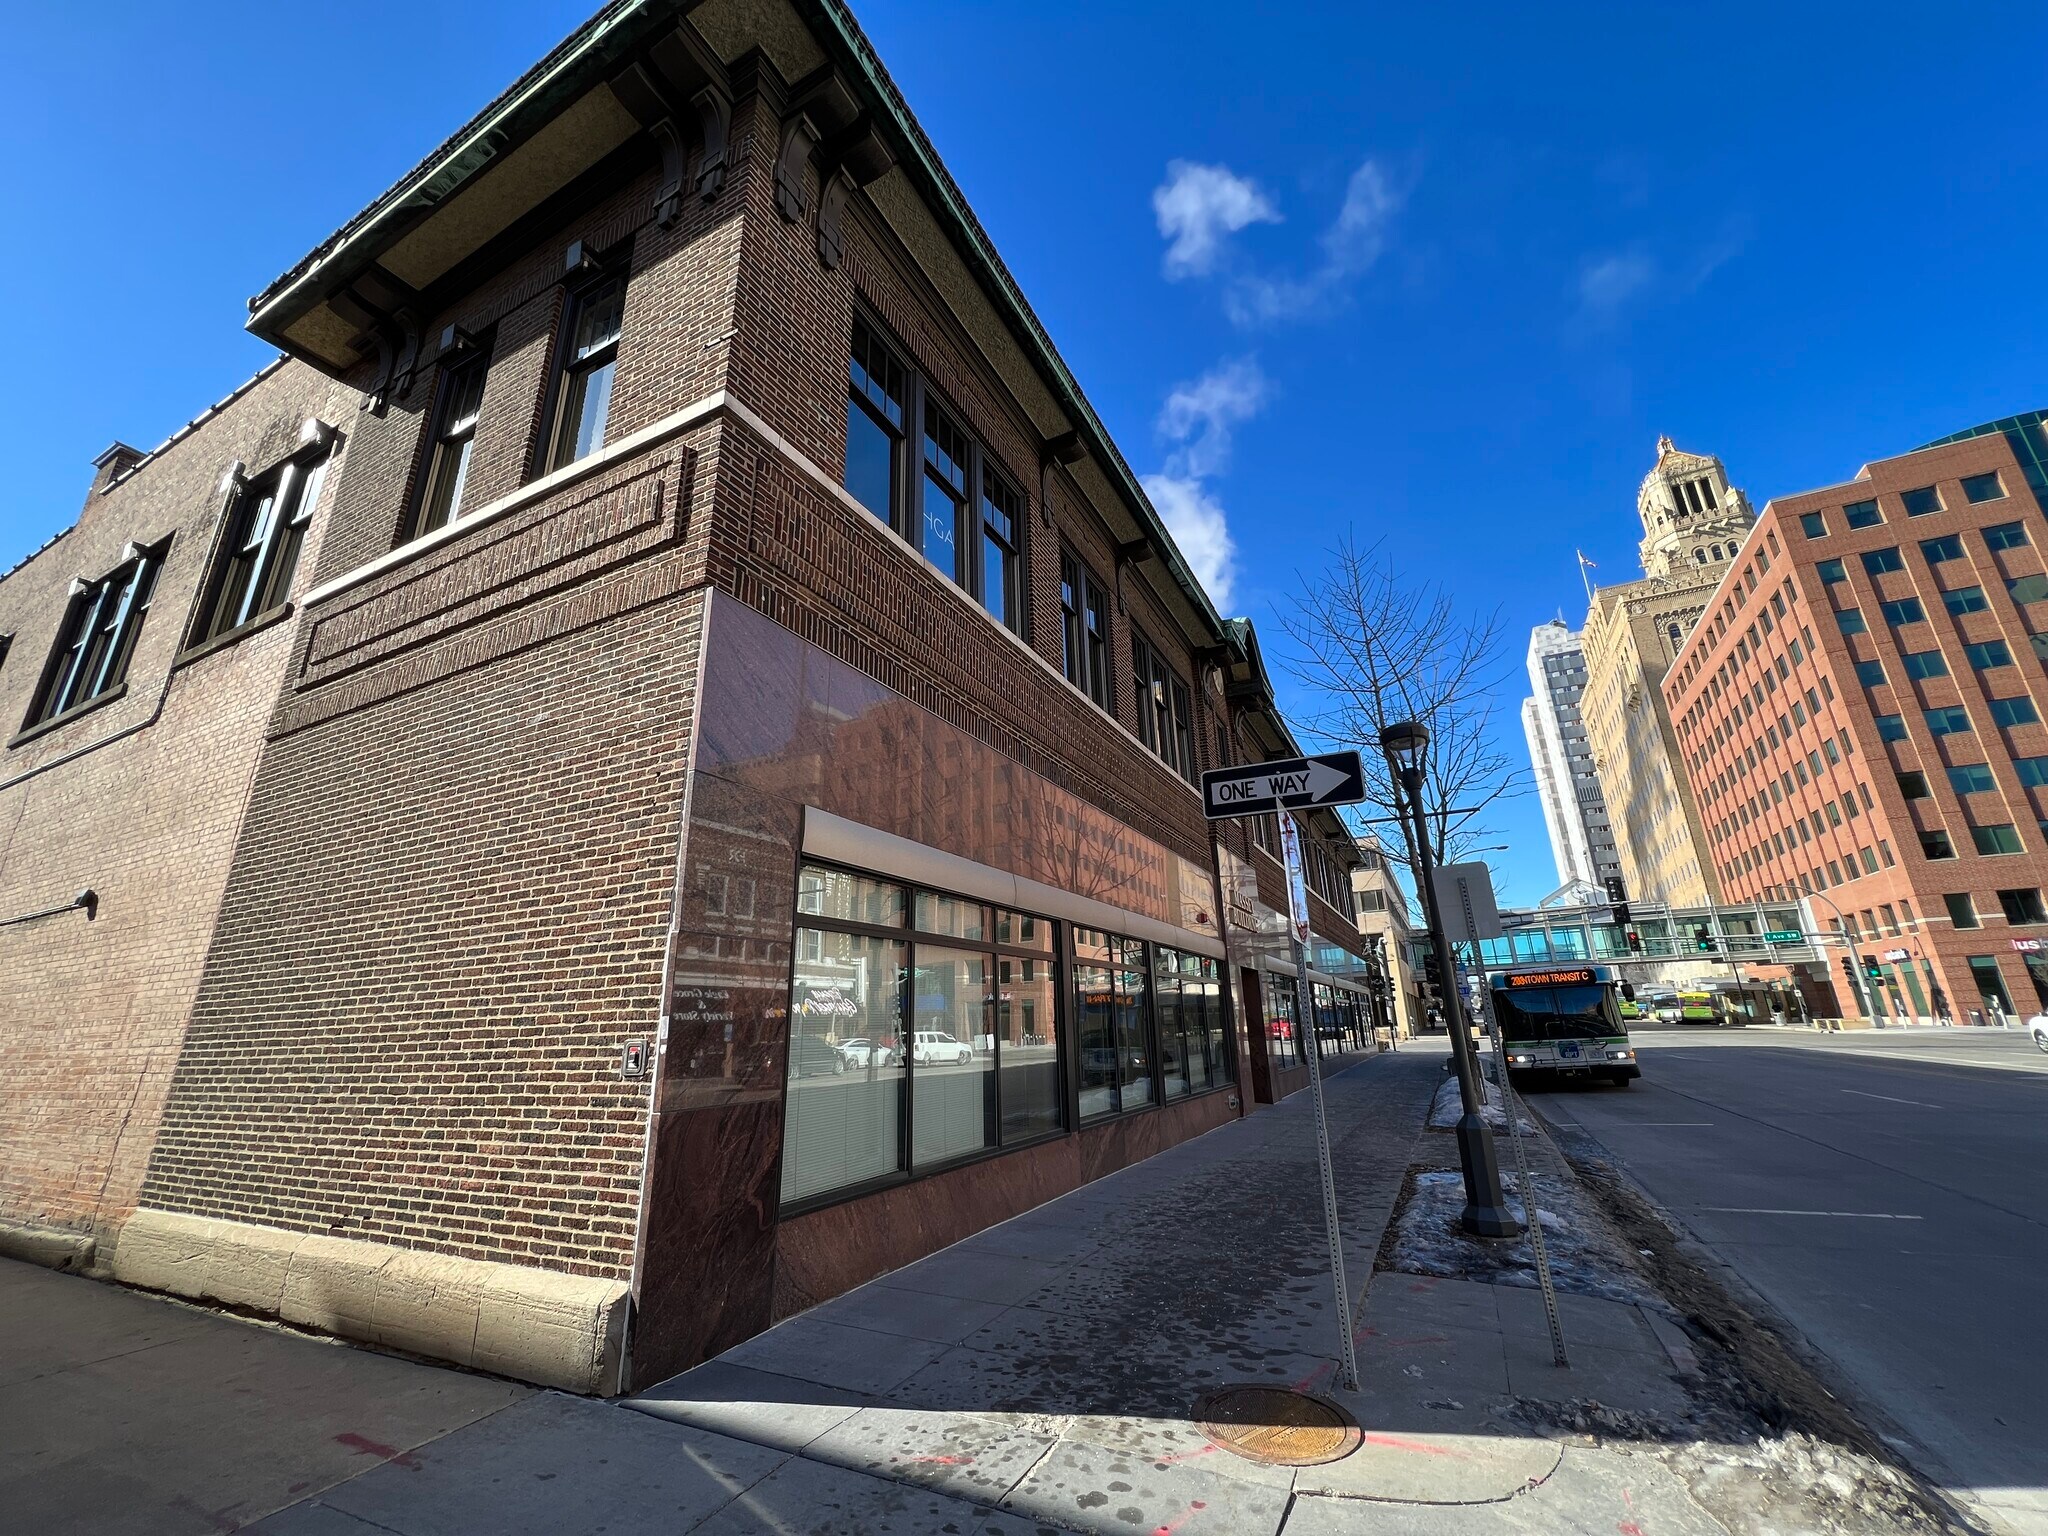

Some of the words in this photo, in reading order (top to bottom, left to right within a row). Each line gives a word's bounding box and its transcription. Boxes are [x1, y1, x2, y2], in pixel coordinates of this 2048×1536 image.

[1219, 781, 1257, 801] ONE
[1268, 772, 1310, 795] WAY
[1550, 972, 1581, 982] TRANSIT
[1582, 971, 1589, 980] C
